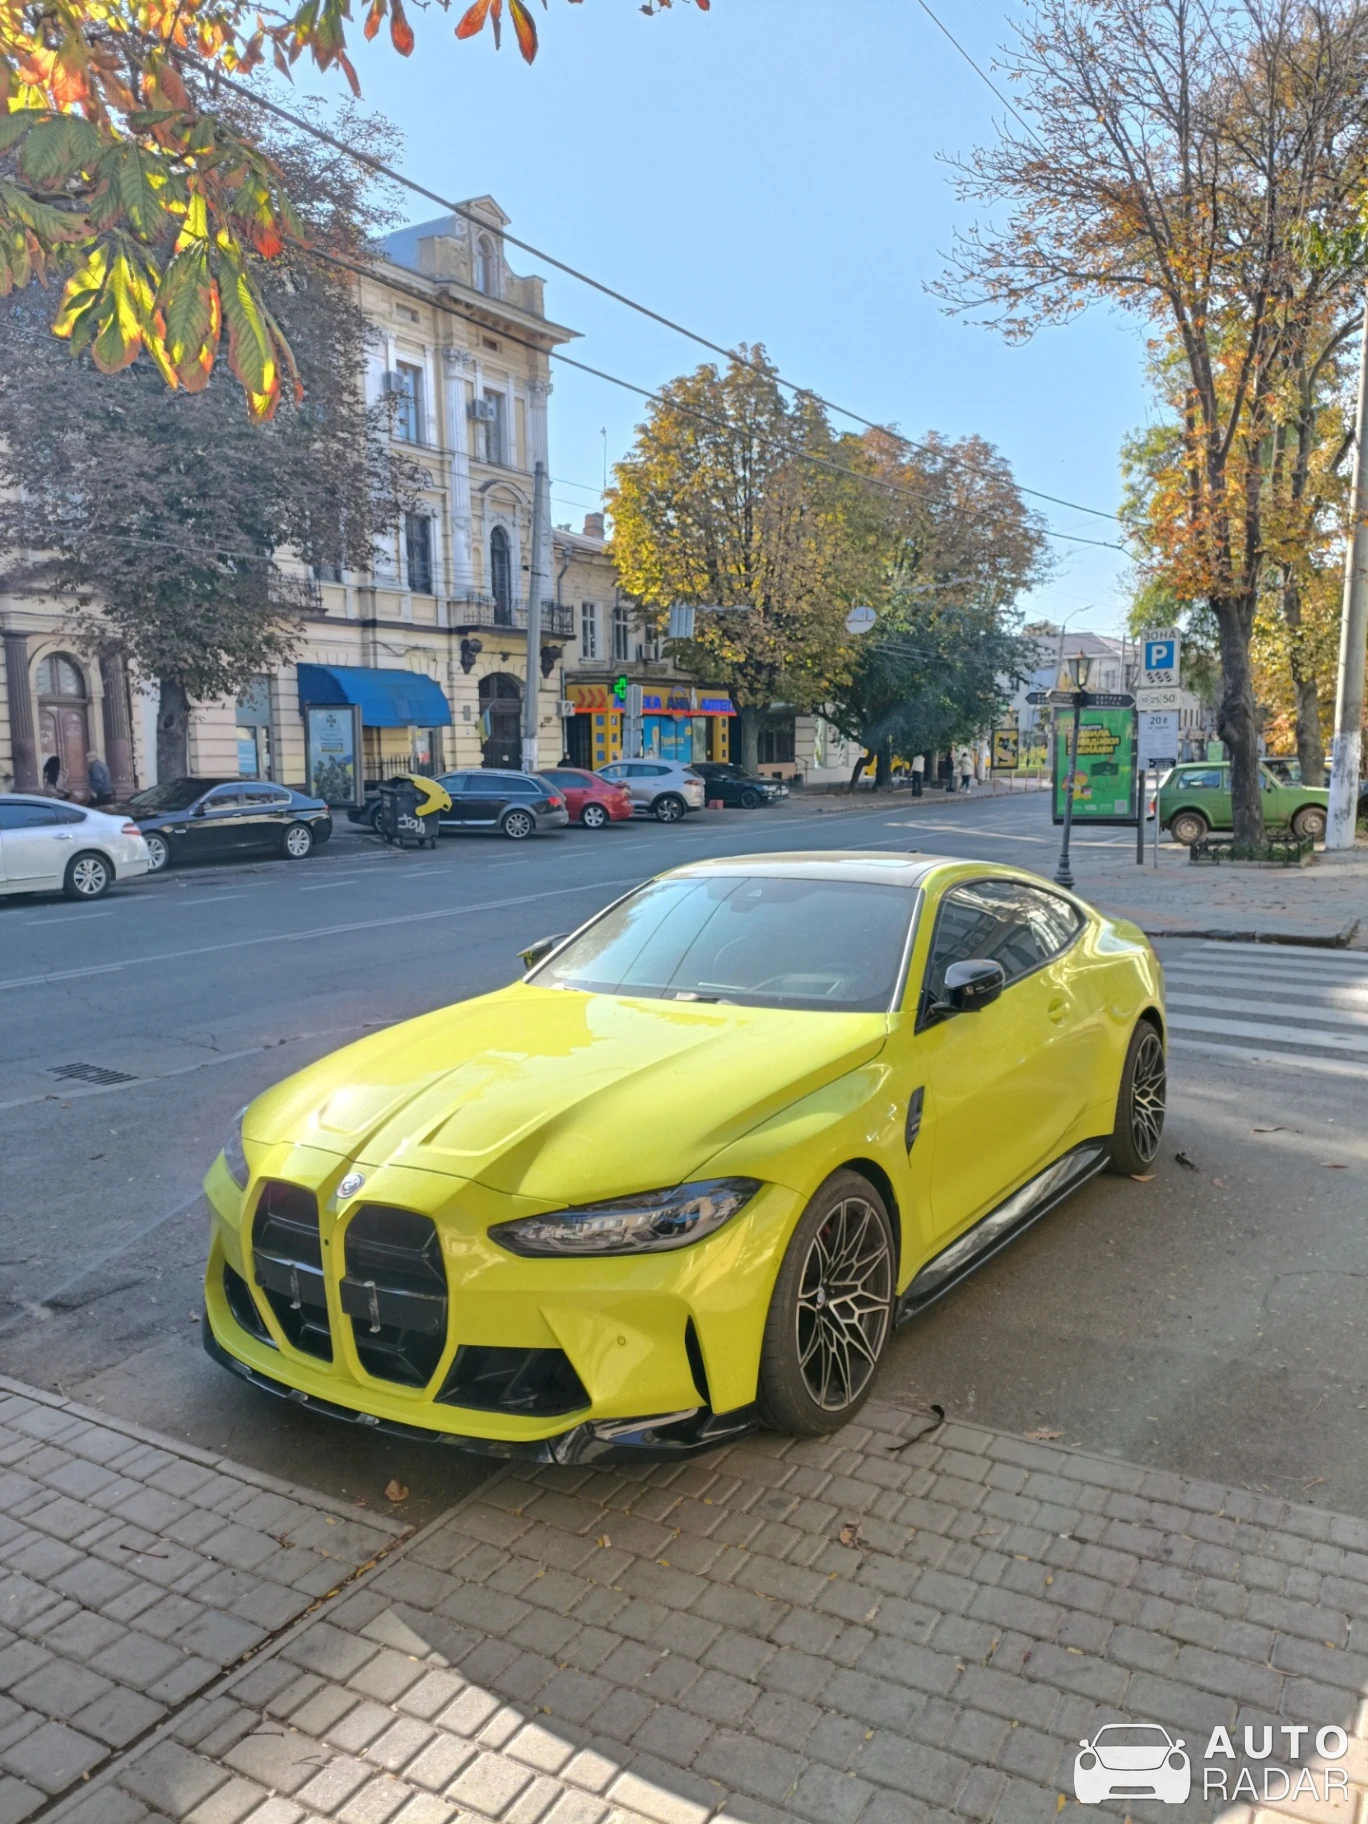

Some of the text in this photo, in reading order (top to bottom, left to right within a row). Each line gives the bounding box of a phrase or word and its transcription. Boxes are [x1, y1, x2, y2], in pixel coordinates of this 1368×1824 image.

[1143, 631, 1176, 641] ЗОНА
[1151, 645, 1168, 667] P
[1162, 693, 1176, 704] 50
[1150, 716, 1162, 725] 20
